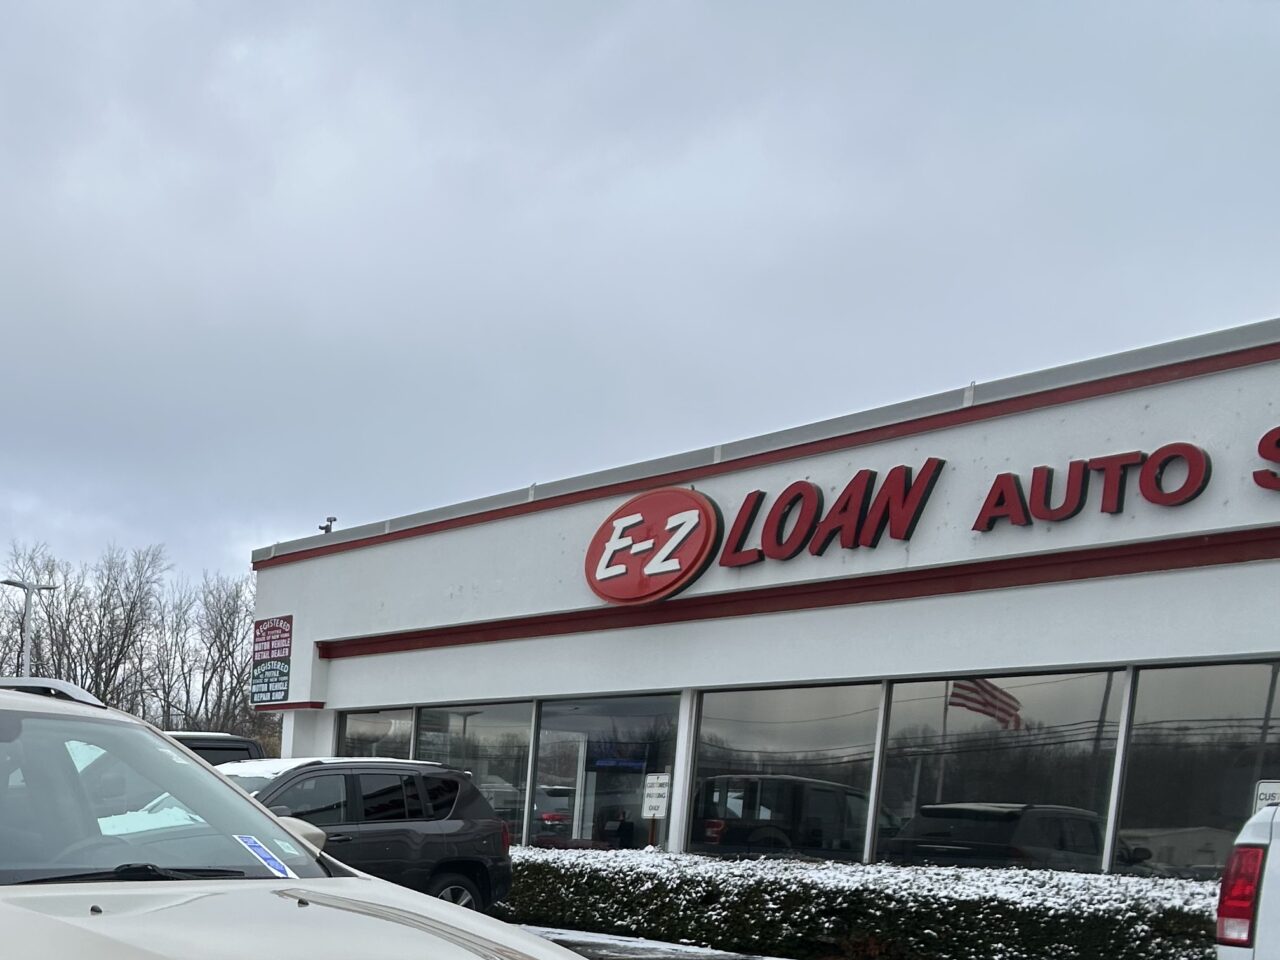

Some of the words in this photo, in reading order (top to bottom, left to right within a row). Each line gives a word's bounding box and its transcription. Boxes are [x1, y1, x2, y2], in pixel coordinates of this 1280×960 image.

[595, 509, 700, 581] E-Z
[719, 457, 946, 569] LOAN
[972, 442, 1212, 532] AUTO
[256, 619, 290, 636] REGISTERED
[271, 638, 290, 649] VEHICLE
[255, 650, 270, 661] RETAIL
[271, 647, 289, 658] DEALER
[254, 661, 288, 676] REGISTERED
[269, 681, 288, 691] VEHICLE
[254, 692, 271, 702] REPAIR
[271, 690, 285, 700] SHOP
